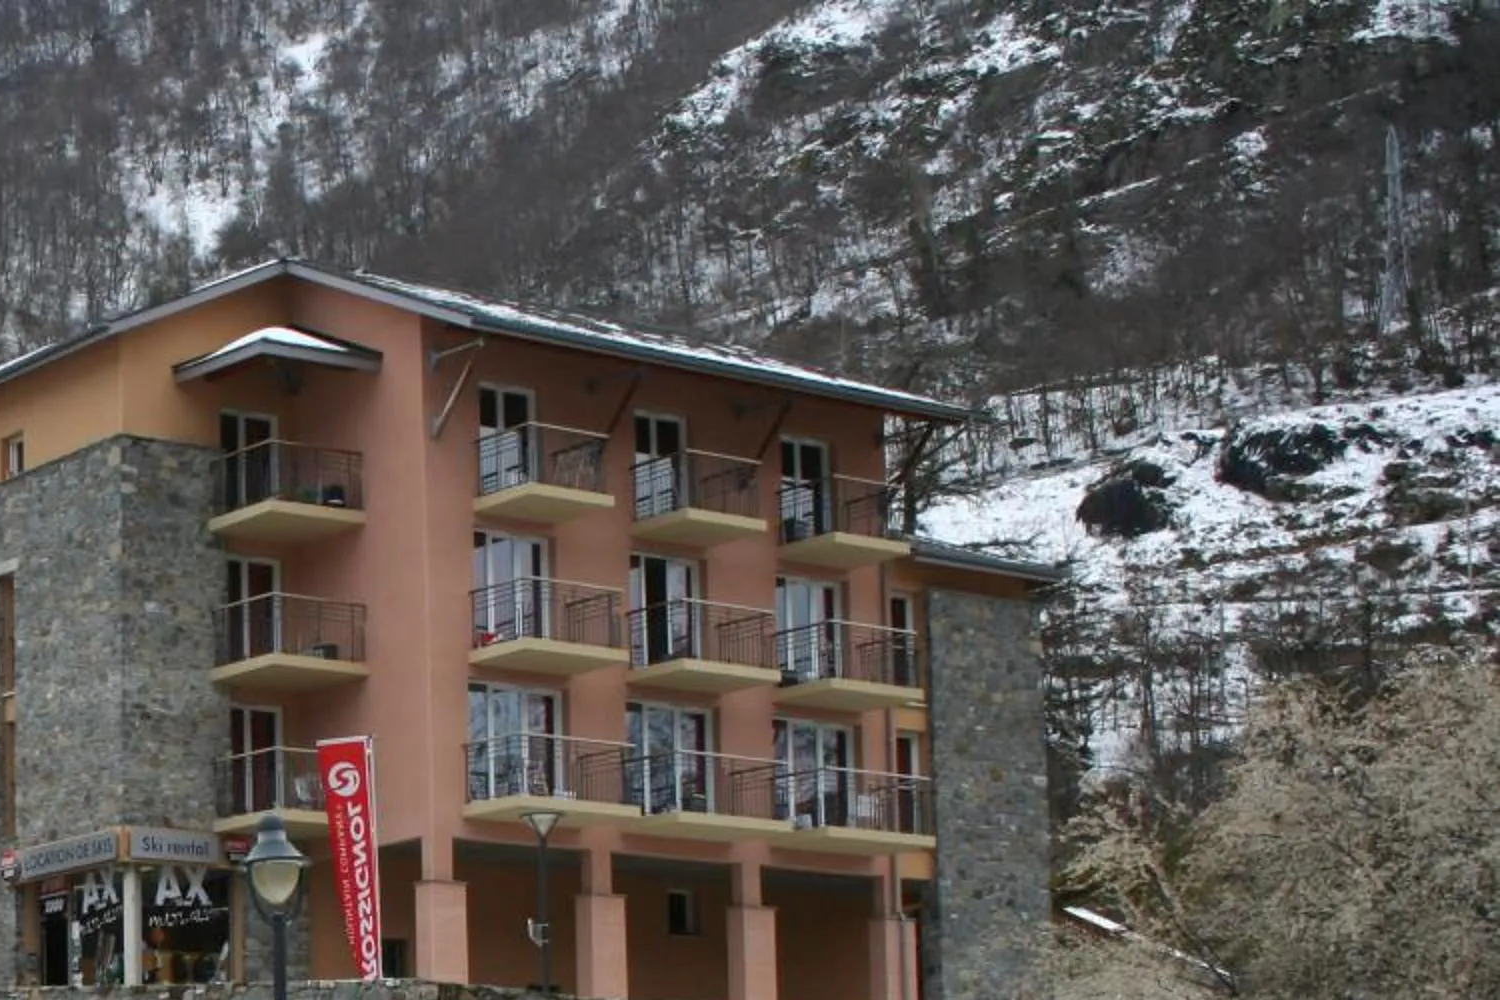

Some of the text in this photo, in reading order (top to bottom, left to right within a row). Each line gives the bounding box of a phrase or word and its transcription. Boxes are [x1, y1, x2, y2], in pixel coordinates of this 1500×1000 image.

[24, 847, 74, 871] LOCATION
[76, 841, 89, 859] DE
[142, 835, 163, 853] Ski
[167, 840, 210, 857] rental
[155, 863, 212, 906] AX
